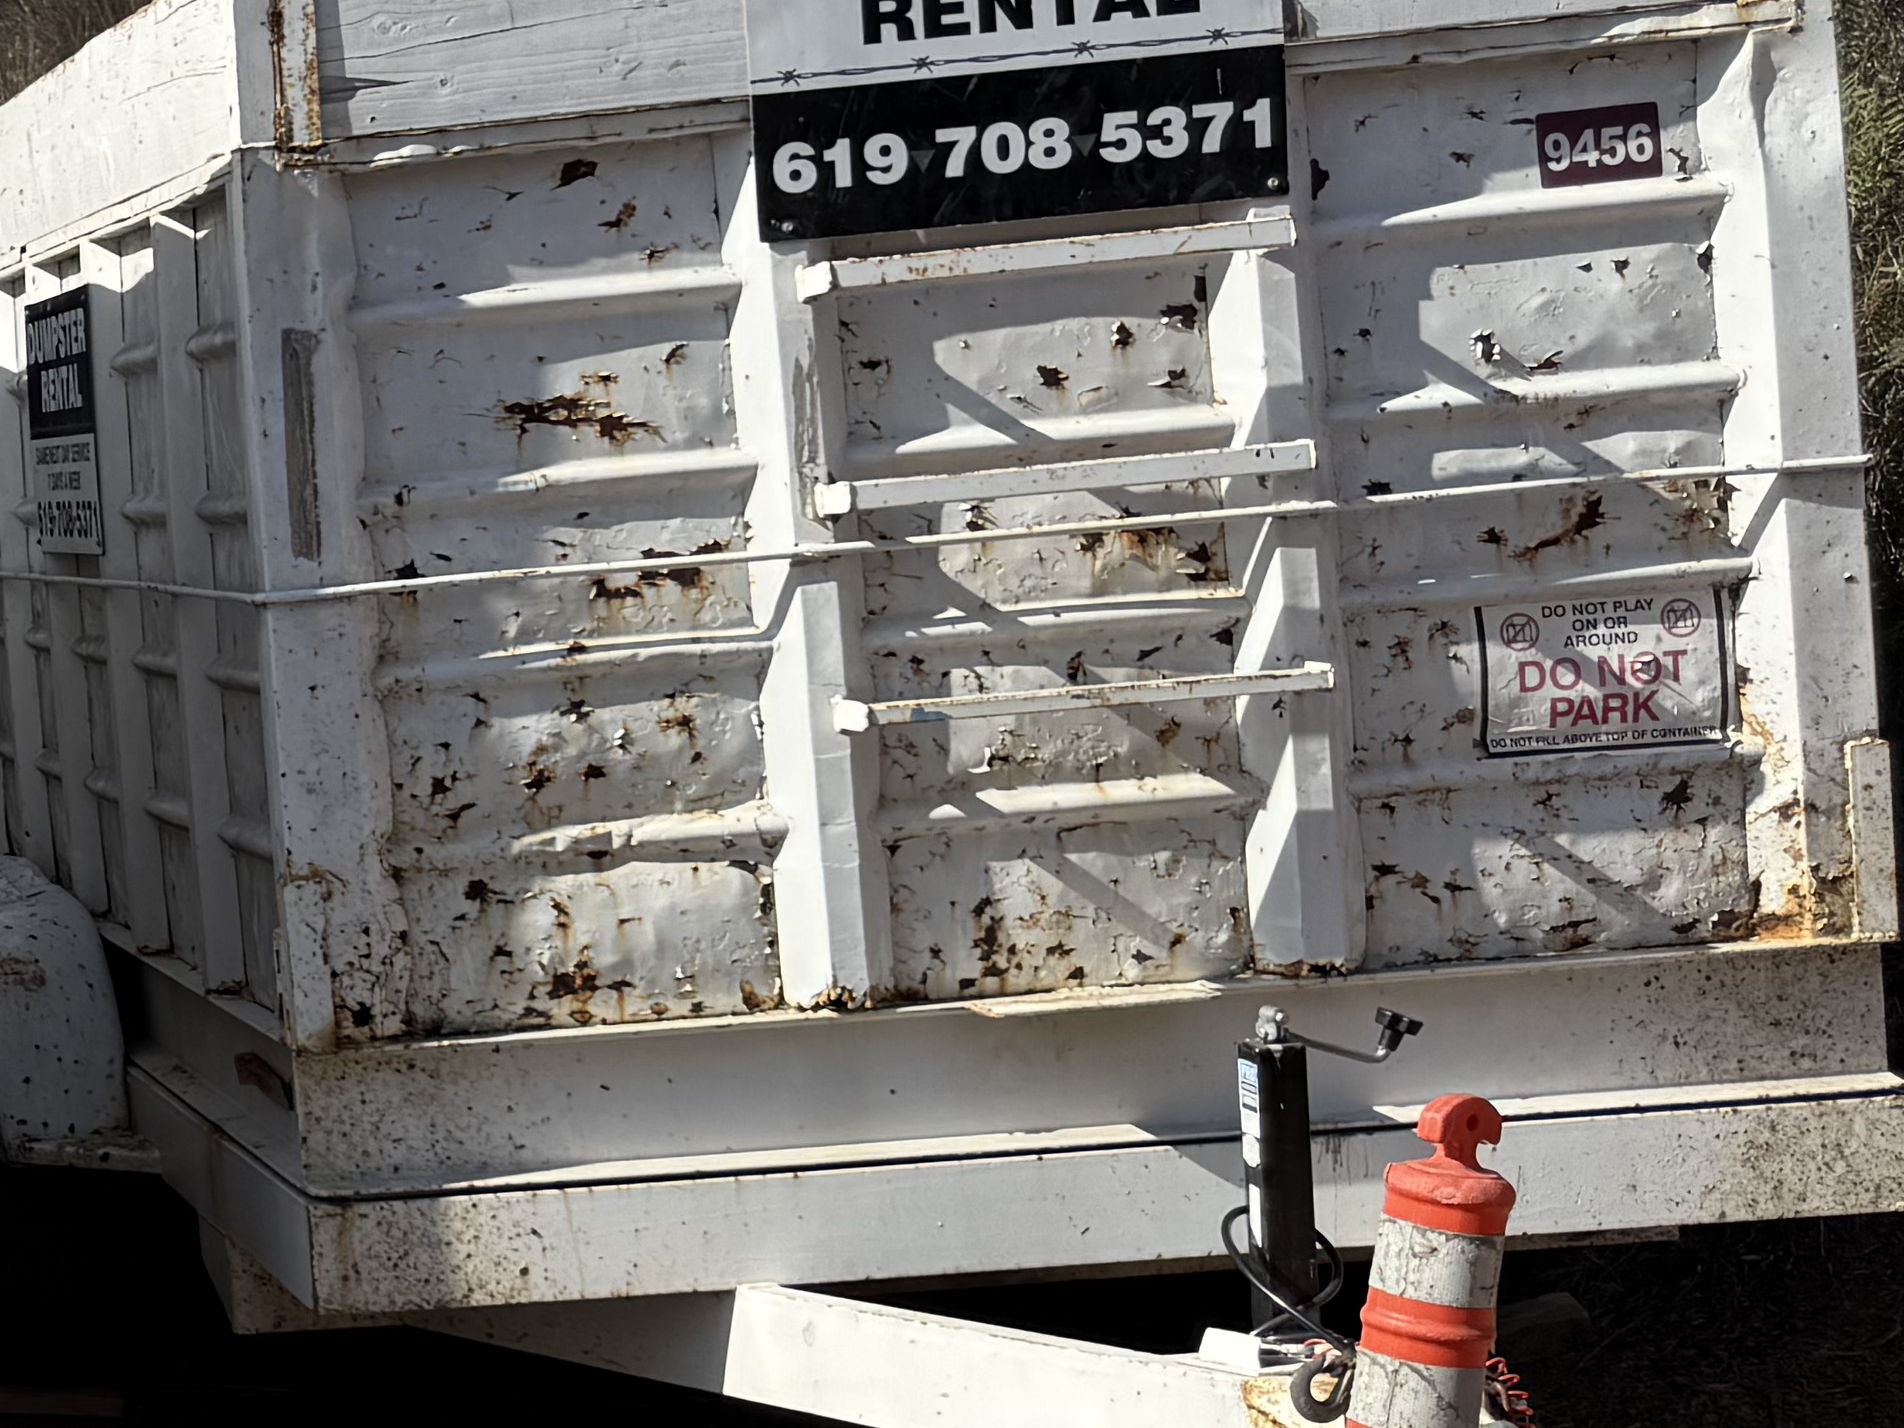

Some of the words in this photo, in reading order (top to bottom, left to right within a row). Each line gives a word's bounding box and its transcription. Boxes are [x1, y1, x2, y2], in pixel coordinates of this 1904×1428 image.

[772, 133, 909, 195] 619
[935, 117, 1073, 178] 708
[1099, 98, 1272, 164] 5371
[1544, 123, 1653, 171] 9456
[27, 307, 87, 365] DUMPSTER
[41, 362, 83, 413] RENTAL
[1541, 604, 1566, 618] DO
[1572, 602, 1608, 616] NOT
[1613, 598, 1654, 613] PLAY
[1572, 618, 1597, 632] ON
[1603, 616, 1628, 630] OR
[1564, 631, 1639, 648] AROUND
[1518, 657, 1582, 693] DO
[1597, 649, 1688, 687] NOT
[1548, 689, 1660, 729] PARK
[1491, 738, 1507, 749] DO
[1510, 736, 1533, 748] NOT
[1562, 733, 1602, 744] ABOVE
[1632, 729, 1648, 740] OF
[1651, 725, 1717, 739] CONTAINER
